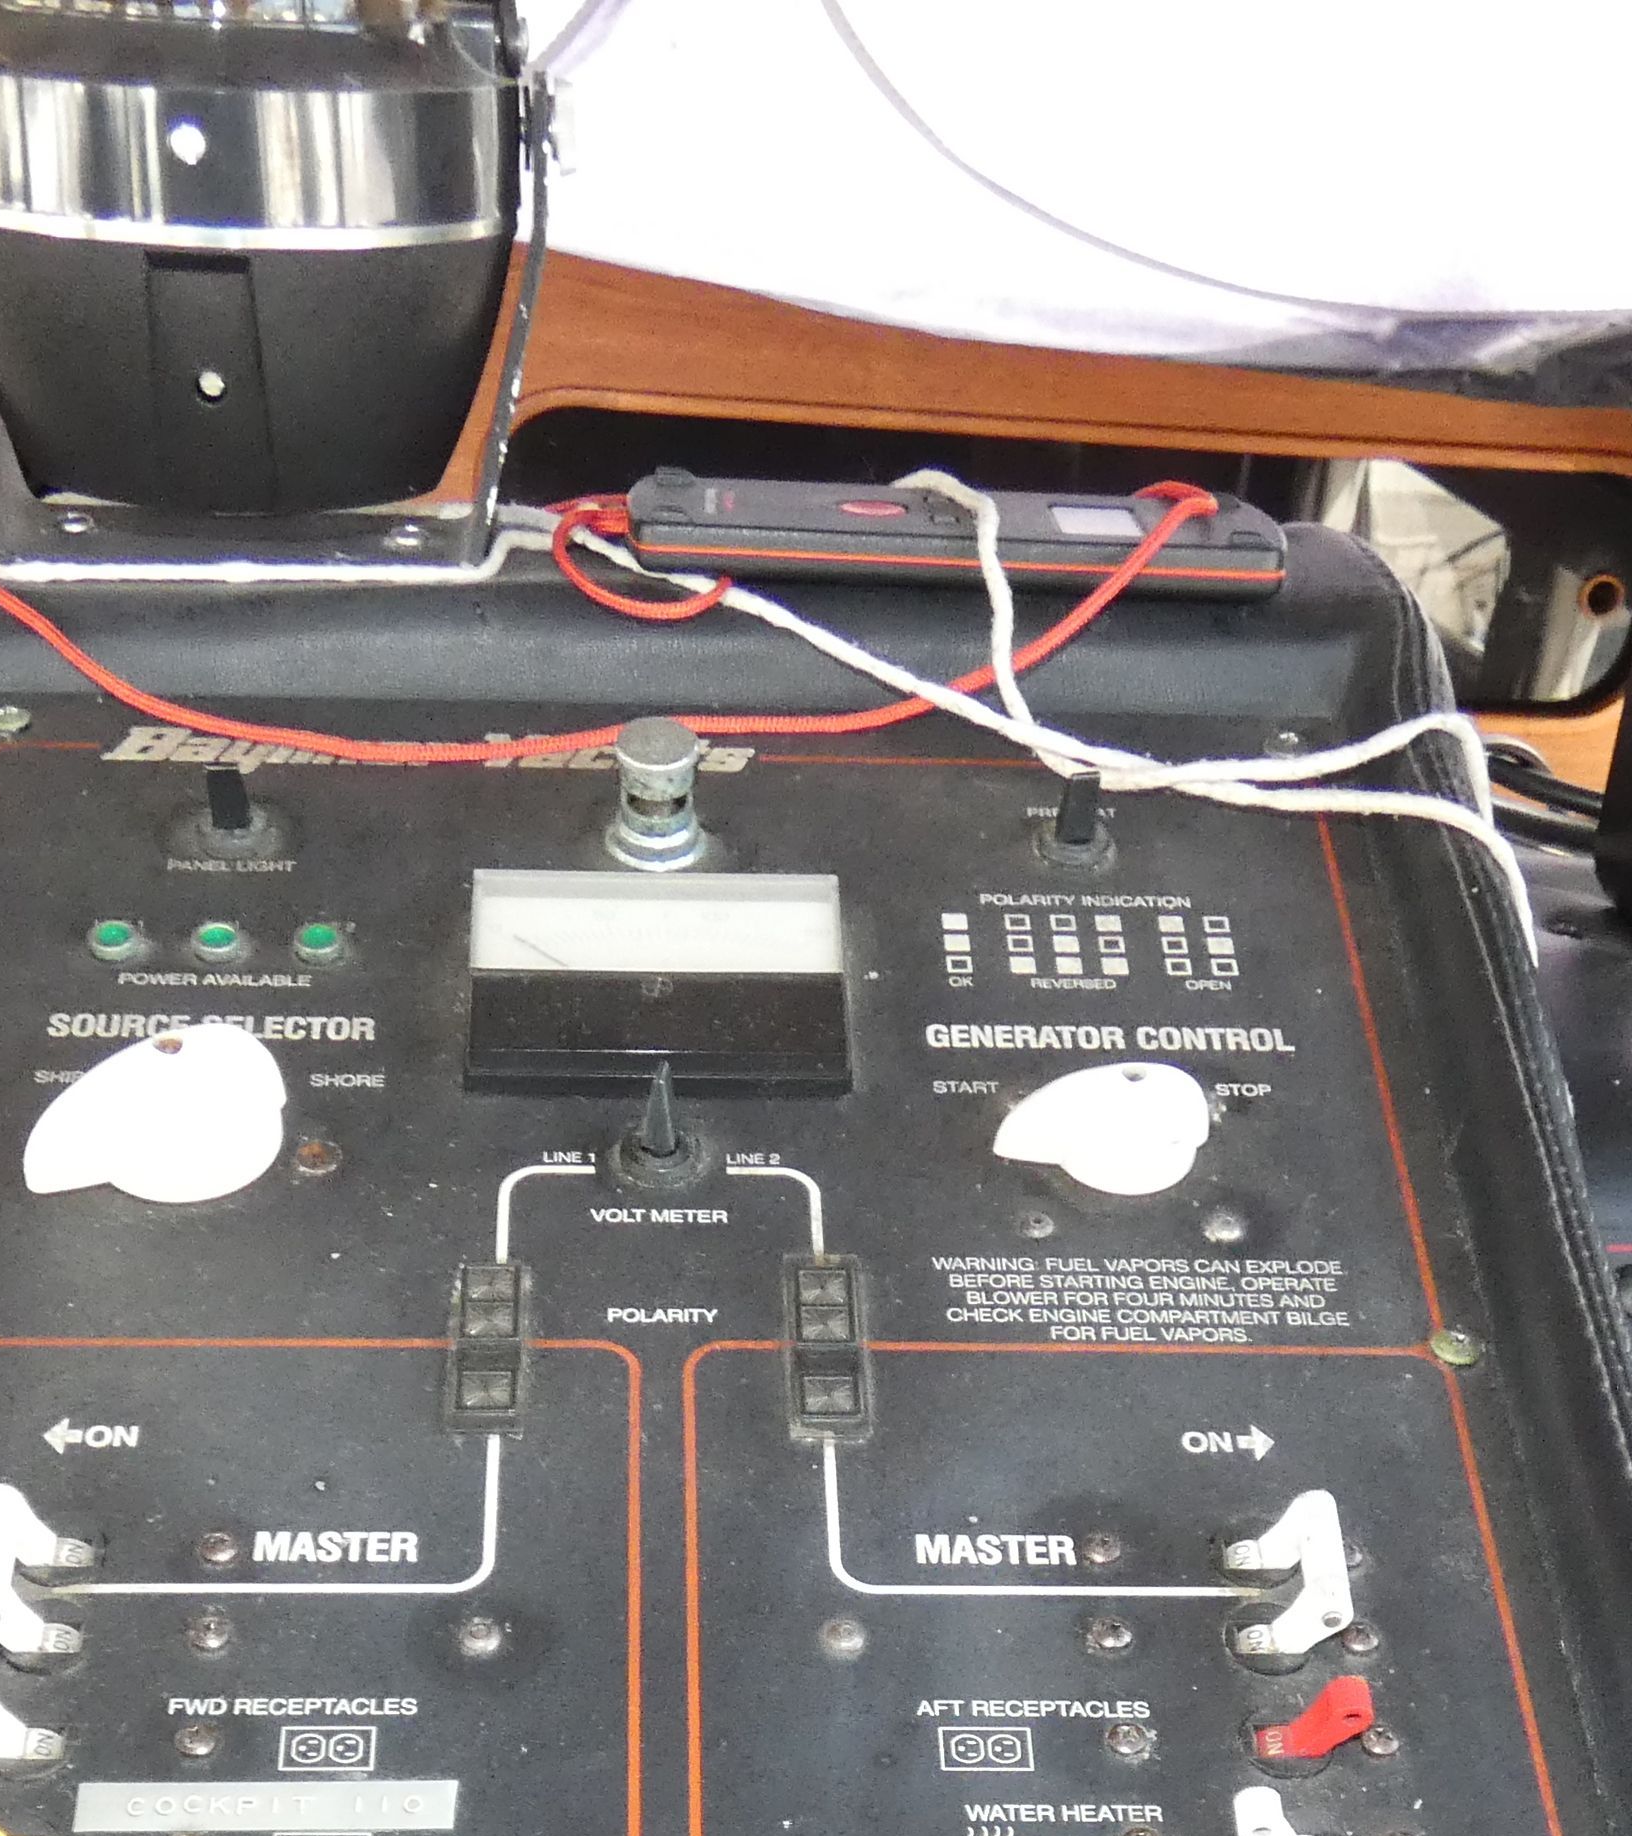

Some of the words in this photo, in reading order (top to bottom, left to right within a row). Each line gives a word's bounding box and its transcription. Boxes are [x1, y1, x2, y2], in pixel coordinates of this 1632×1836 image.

[167, 860, 231, 872] PANEL
[236, 861, 297, 873] LIGHT
[979, 893, 1075, 907] POLARITY
[1081, 894, 1192, 909] INDICATION
[118, 973, 198, 987] POWER
[202, 973, 313, 988] AVAILABLE
[948, 976, 974, 988] OK
[1031, 977, 1117, 991] REVERSED
[1185, 979, 1232, 991] OPEN
[925, 1024, 1126, 1050] GENERATOR
[1136, 1026, 1296, 1052] CONTROL
[309, 1073, 386, 1088] SHORE
[932, 1080, 999, 1095] START
[1216, 1083, 1272, 1098] STOP
[543, 1151, 583, 1164] LINE
[587, 1152, 596, 1164] 1
[726, 1152, 763, 1165] LINE
[768, 1153, 781, 1165] 2
[590, 1207, 645, 1224] VOLT
[651, 1208, 729, 1225] METER
[1046, 1257, 1099, 1273] FUEL
[1103, 1258, 1190, 1274] VAPORS
[1193, 1259, 1241, 1275] CAN
[949, 1273, 1035, 1290] BEFORE
[1040, 1274, 1145, 1291] STARTING
[1150, 1275, 1236, 1292] ENGINE,
[1241, 1276, 1338, 1292] OPERATE
[966, 1290, 1060, 1306] BLOWER
[1065, 1291, 1109, 1307] FOR
[1113, 1292, 1174, 1308] FOUR
[1179, 1293, 1274, 1309] MINUTES
[1279, 1294, 1325, 1309] AND
[606, 1307, 718, 1324] POLARITY
[946, 1307, 1024, 1324] CHECK
[1029, 1308, 1111, 1325] ENGINE
[1116, 1310, 1281, 1326] COMPARTMENT
[1285, 1311, 1350, 1327] BILGE
[1050, 1325, 1097, 1342] FOR
[1101, 1326, 1156, 1342] FUEL
[1160, 1327, 1253, 1343] VAPORS.
[84, 1425, 139, 1448] ON
[1181, 1431, 1234, 1454] ON
[252, 1531, 419, 1563] MASTER
[915, 1535, 1077, 1567] MASTER
[168, 1699, 229, 1716] FWD
[233, 1698, 419, 1716] RECEPTACLES
[916, 1700, 965, 1718] AFT
[971, 1700, 1151, 1719] RECEPTACLES
[127, 1795, 316, 1817] COCKPIT
[965, 1804, 1056, 1823] WATER
[1061, 1804, 1164, 1823] HEATER
